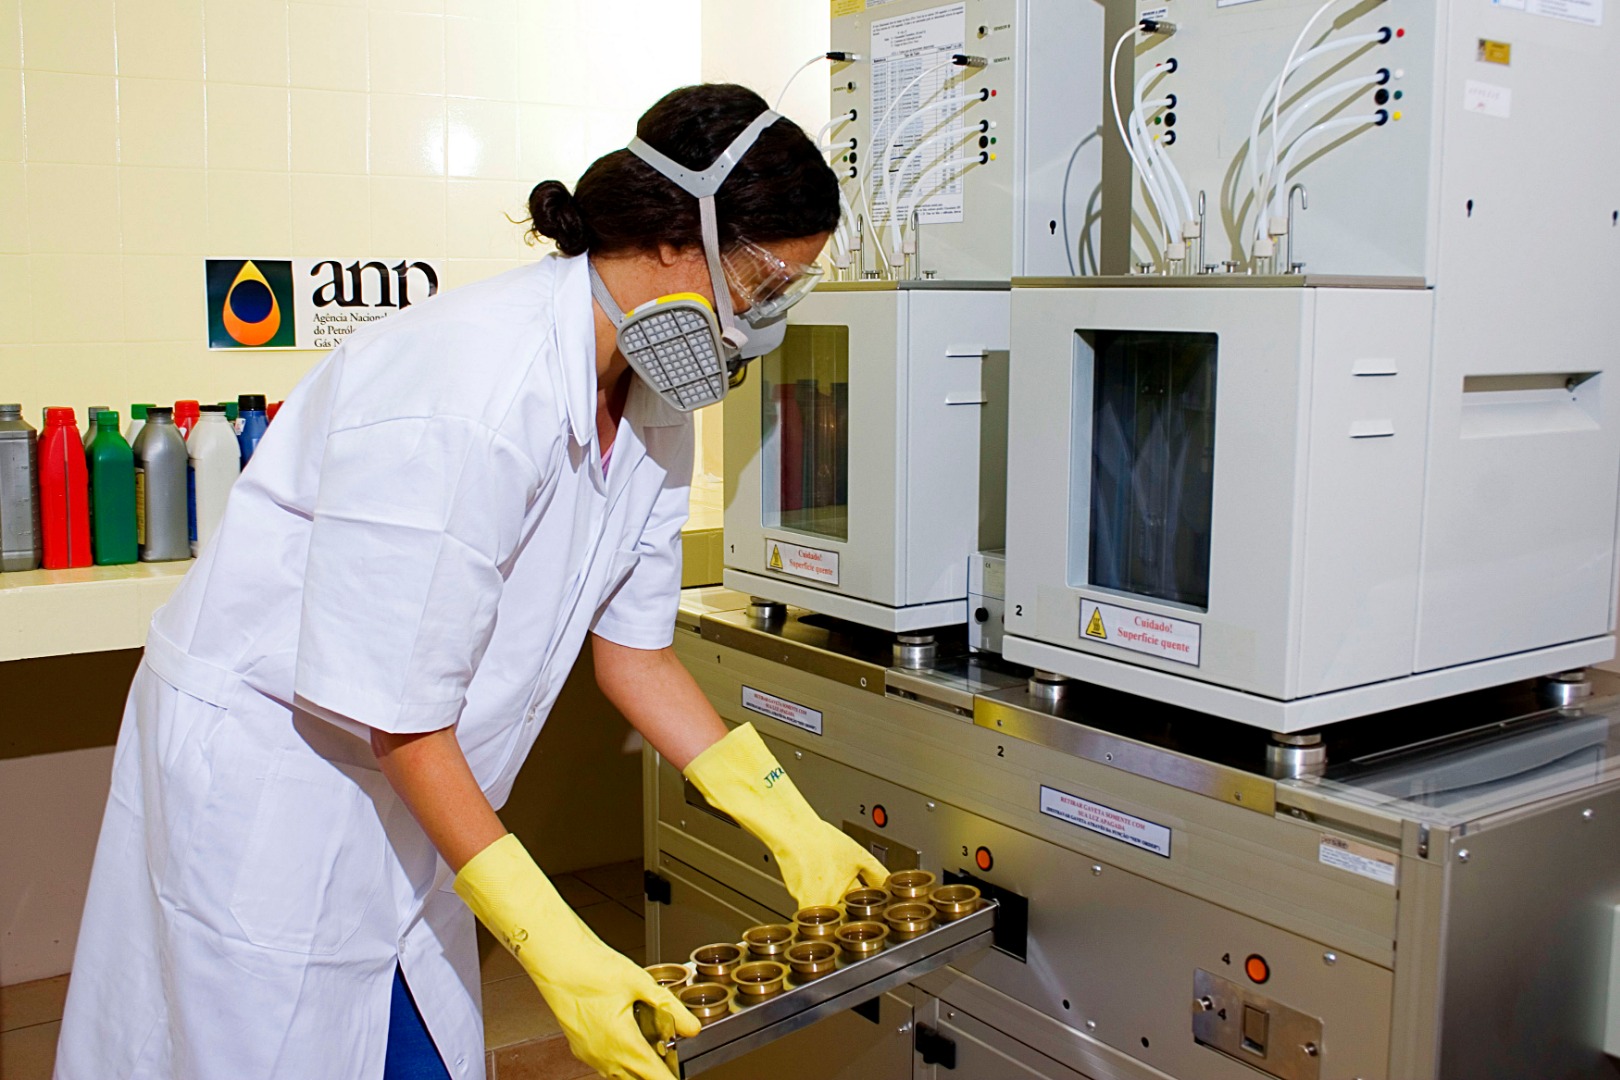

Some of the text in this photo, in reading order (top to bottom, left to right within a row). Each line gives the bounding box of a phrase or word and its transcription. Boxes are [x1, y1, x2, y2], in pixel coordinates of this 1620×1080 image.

[313, 312, 388, 325] Agência Nacion
[313, 325, 357, 335] do Petról
[314, 338, 331, 348] Gás
[730, 544, 735, 553] 1
[1015, 604, 1023, 617] 2
[1134, 615, 1173, 633] Cuidado!
[1160, 639, 1190, 653] quente
[997, 745, 1005, 758] 2
[859, 804, 866, 815] 2
[962, 845, 969, 857] 3
[1222, 952, 1231, 966] 4
[1217, 1007, 1227, 1021] 4
